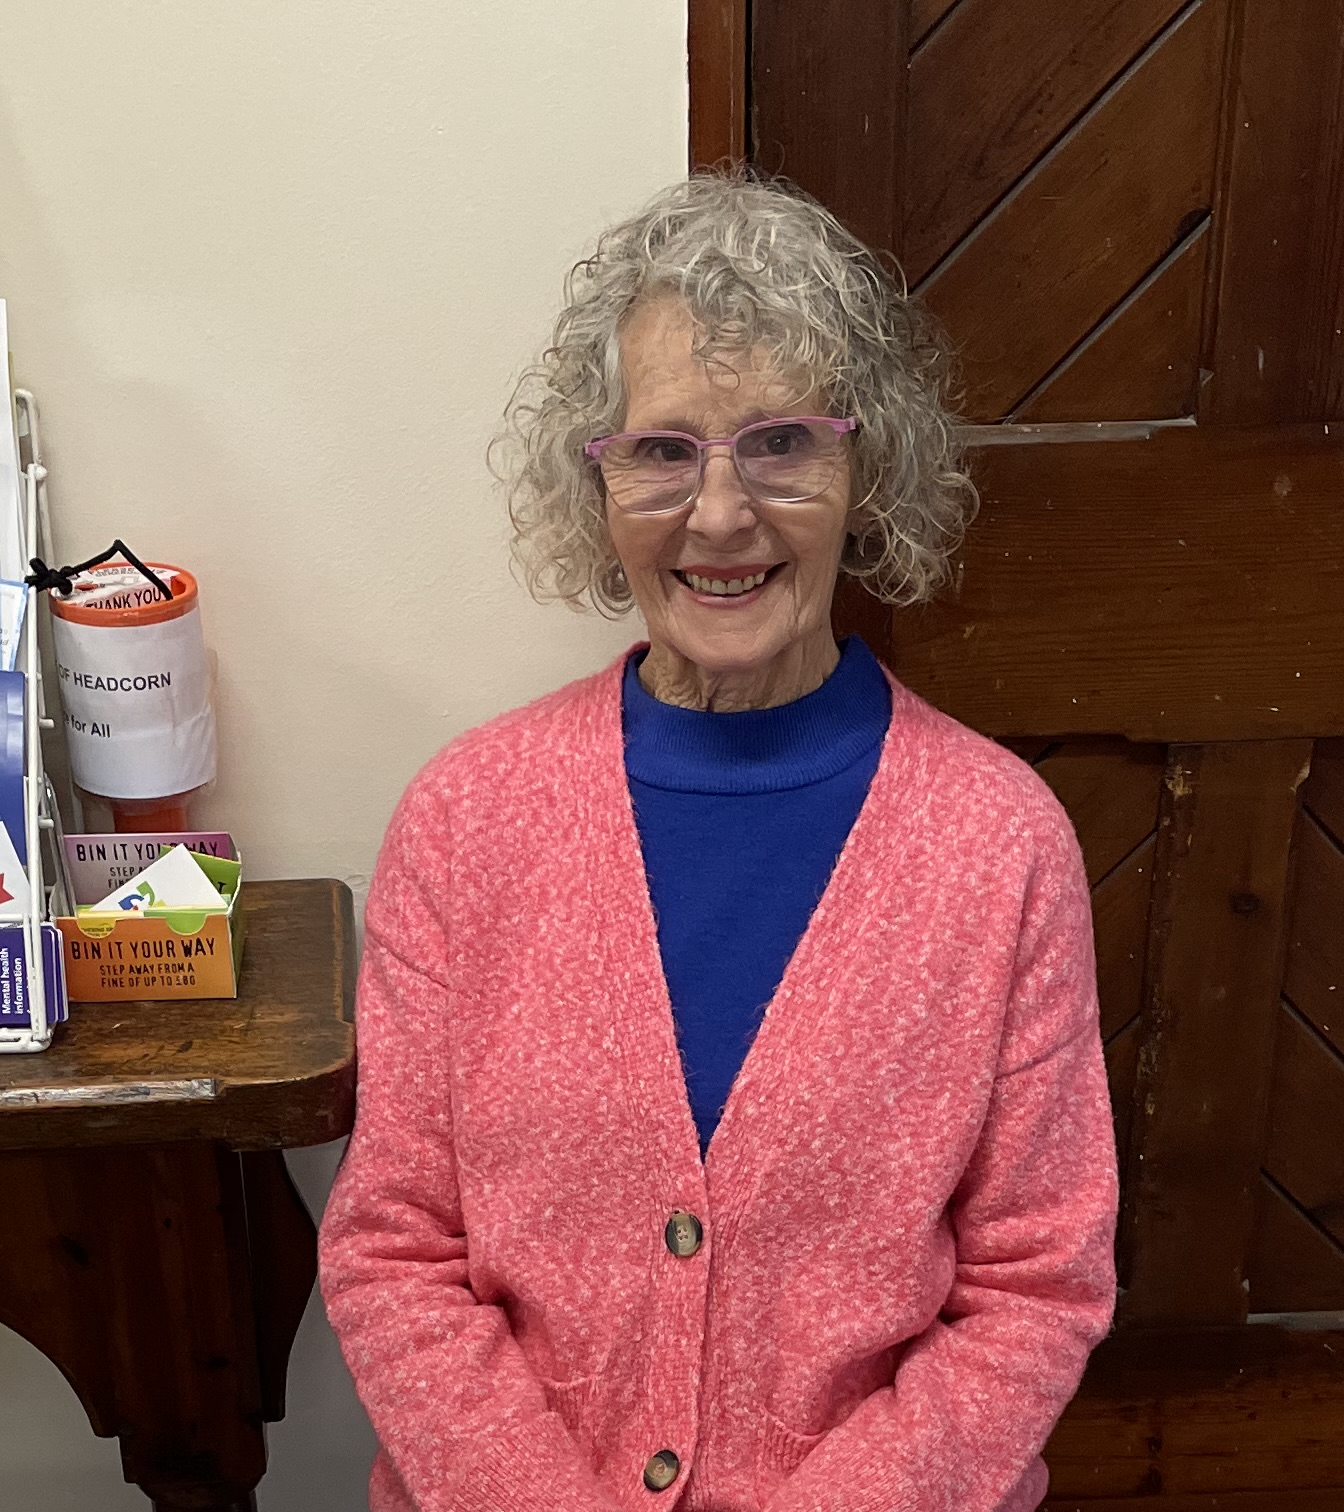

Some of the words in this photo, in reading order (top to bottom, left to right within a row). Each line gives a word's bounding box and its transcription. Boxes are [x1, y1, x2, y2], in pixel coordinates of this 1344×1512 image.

[73, 671, 172, 692] HEADCORN
[70, 715, 87, 733] for
[90, 722, 111, 739] All
[76, 843, 107, 862] BIN
[113, 843, 128, 861] IT
[109, 866, 135, 877] STEP
[70, 940, 102, 961] BIN
[108, 940, 124, 960] IT
[128, 938, 176, 959] YOUR
[180, 936, 216, 958] WAY
[0, 947, 11, 979] health
[99, 964, 126, 976] STEP
[128, 962, 155, 976] AWAY
[157, 962, 186, 975] FROM
[13, 957, 24, 1015] information
[101, 976, 125, 988] FINE
[127, 976, 142, 988] OF
[143, 975, 157, 987] UP
[159, 975, 173, 986] TO
[0, 981, 12, 1015] Mental
